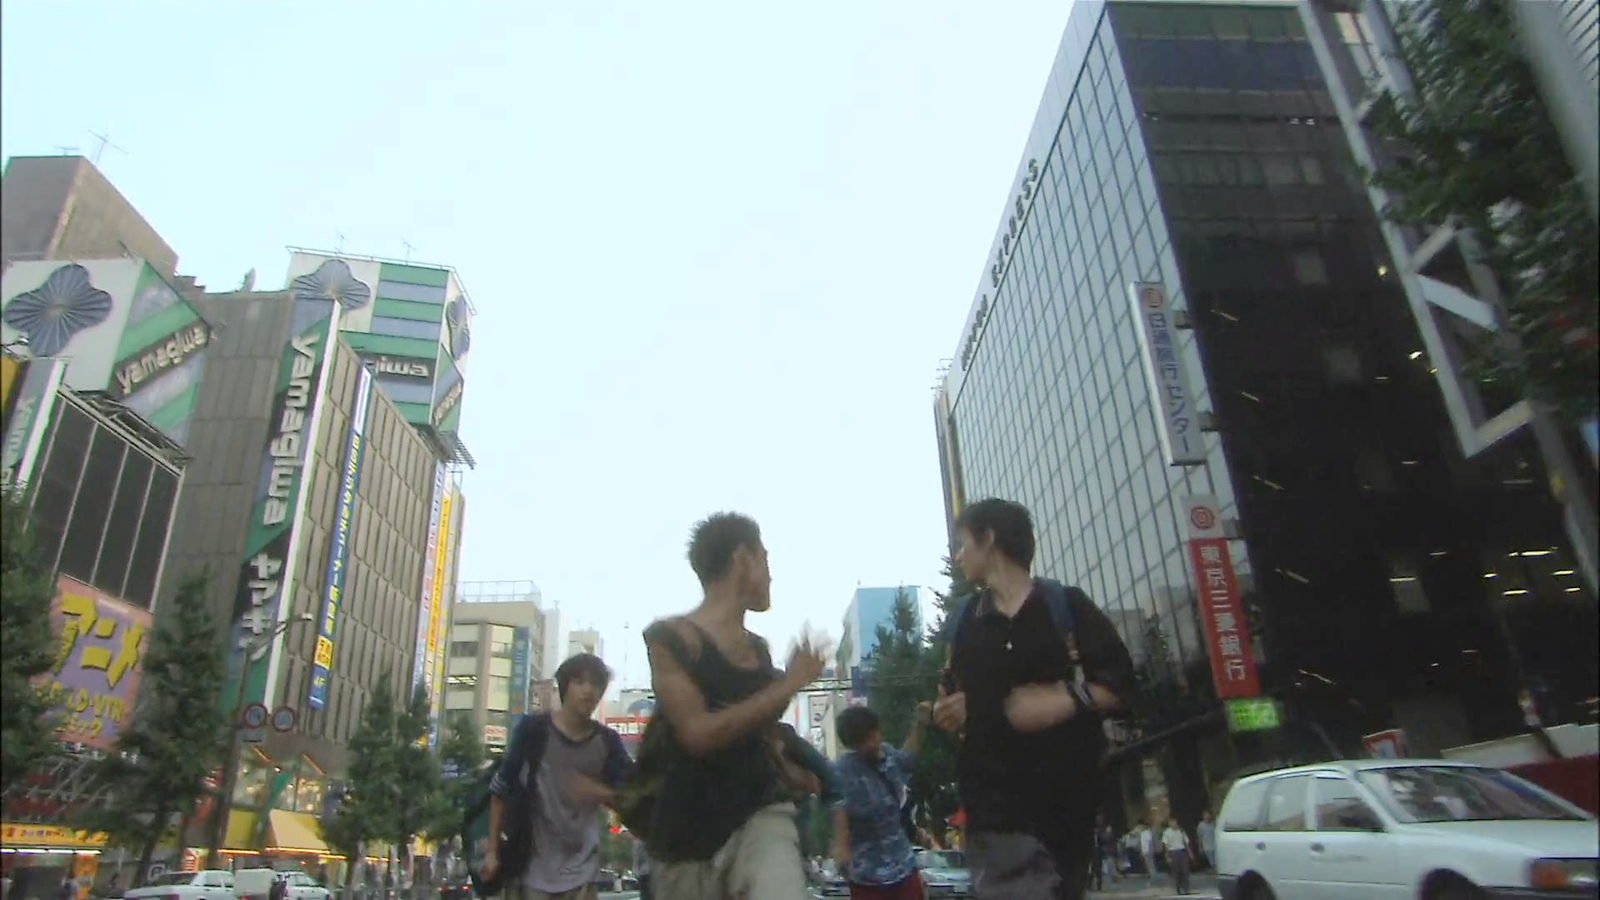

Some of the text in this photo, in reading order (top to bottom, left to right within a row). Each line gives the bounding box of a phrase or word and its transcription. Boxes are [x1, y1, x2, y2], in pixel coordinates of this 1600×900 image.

[991, 158, 1039, 288] EXPRESS
[116, 323, 207, 395] yamagiwa
[263, 332, 320, 526] yamagiwa
[52, 591, 143, 690] アニメ
[238, 553, 283, 662] ヤマギワ
